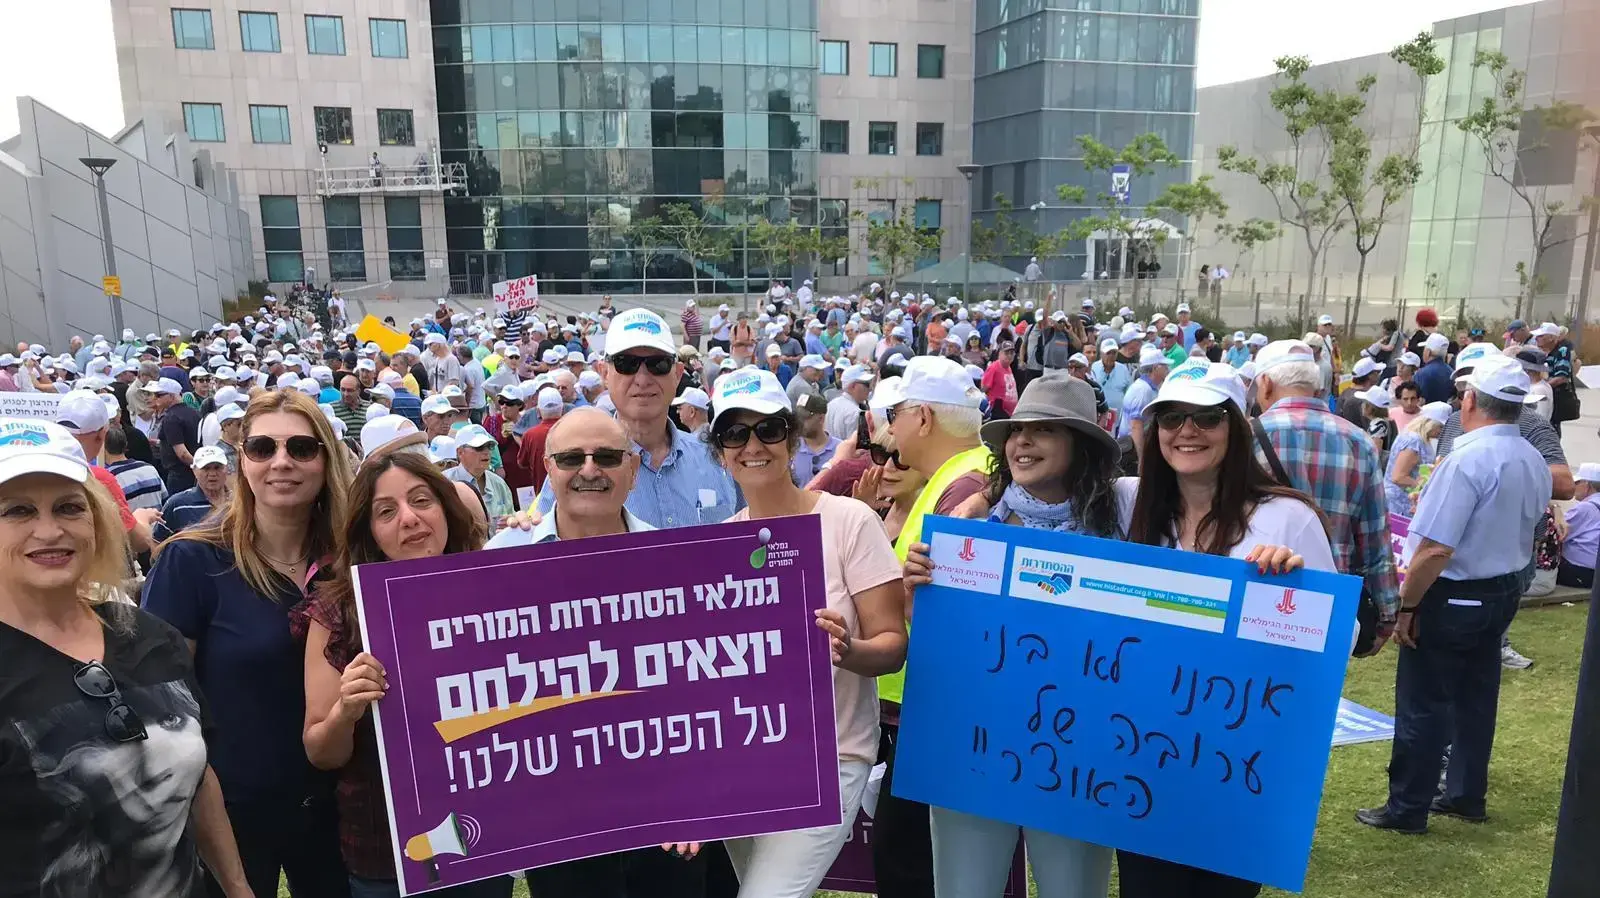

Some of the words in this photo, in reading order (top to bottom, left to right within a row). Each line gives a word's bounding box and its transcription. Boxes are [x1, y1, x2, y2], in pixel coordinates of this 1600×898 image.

[29, 399, 53, 407] הרצון
[767, 541, 789, 550] גמלאי
[768, 549, 799, 560] הסתדרות
[769, 558, 793, 568] המורים
[1021, 556, 1075, 574] ההסתדרות
[934, 563, 964, 575] הגימלאי
[950, 576, 977, 586] בישראל
[966, 569, 1000, 581] הסתדרות
[550, 587, 685, 631] הסתדרות
[693, 574, 780, 611] גמלאי
[428, 606, 541, 650] המורים
[1242, 616, 1281, 629] הגימלאים
[1265, 629, 1296, 642] בישראל
[1284, 622, 1324, 636] הסתדרות
[634, 630, 783, 688] יוצאים
[984, 626, 1048, 674] בני
[1083, 636, 1141, 684] לא
[435, 640, 619, 721] להילחם
[1172, 665, 1294, 731] אנחנו
[734, 697, 787, 746] על
[1028, 685, 1075, 745] של
[573, 711, 722, 768] הפנסיה
[1110, 713, 1263, 796] ערובה
[445, 733, 558, 793] שלנו!
